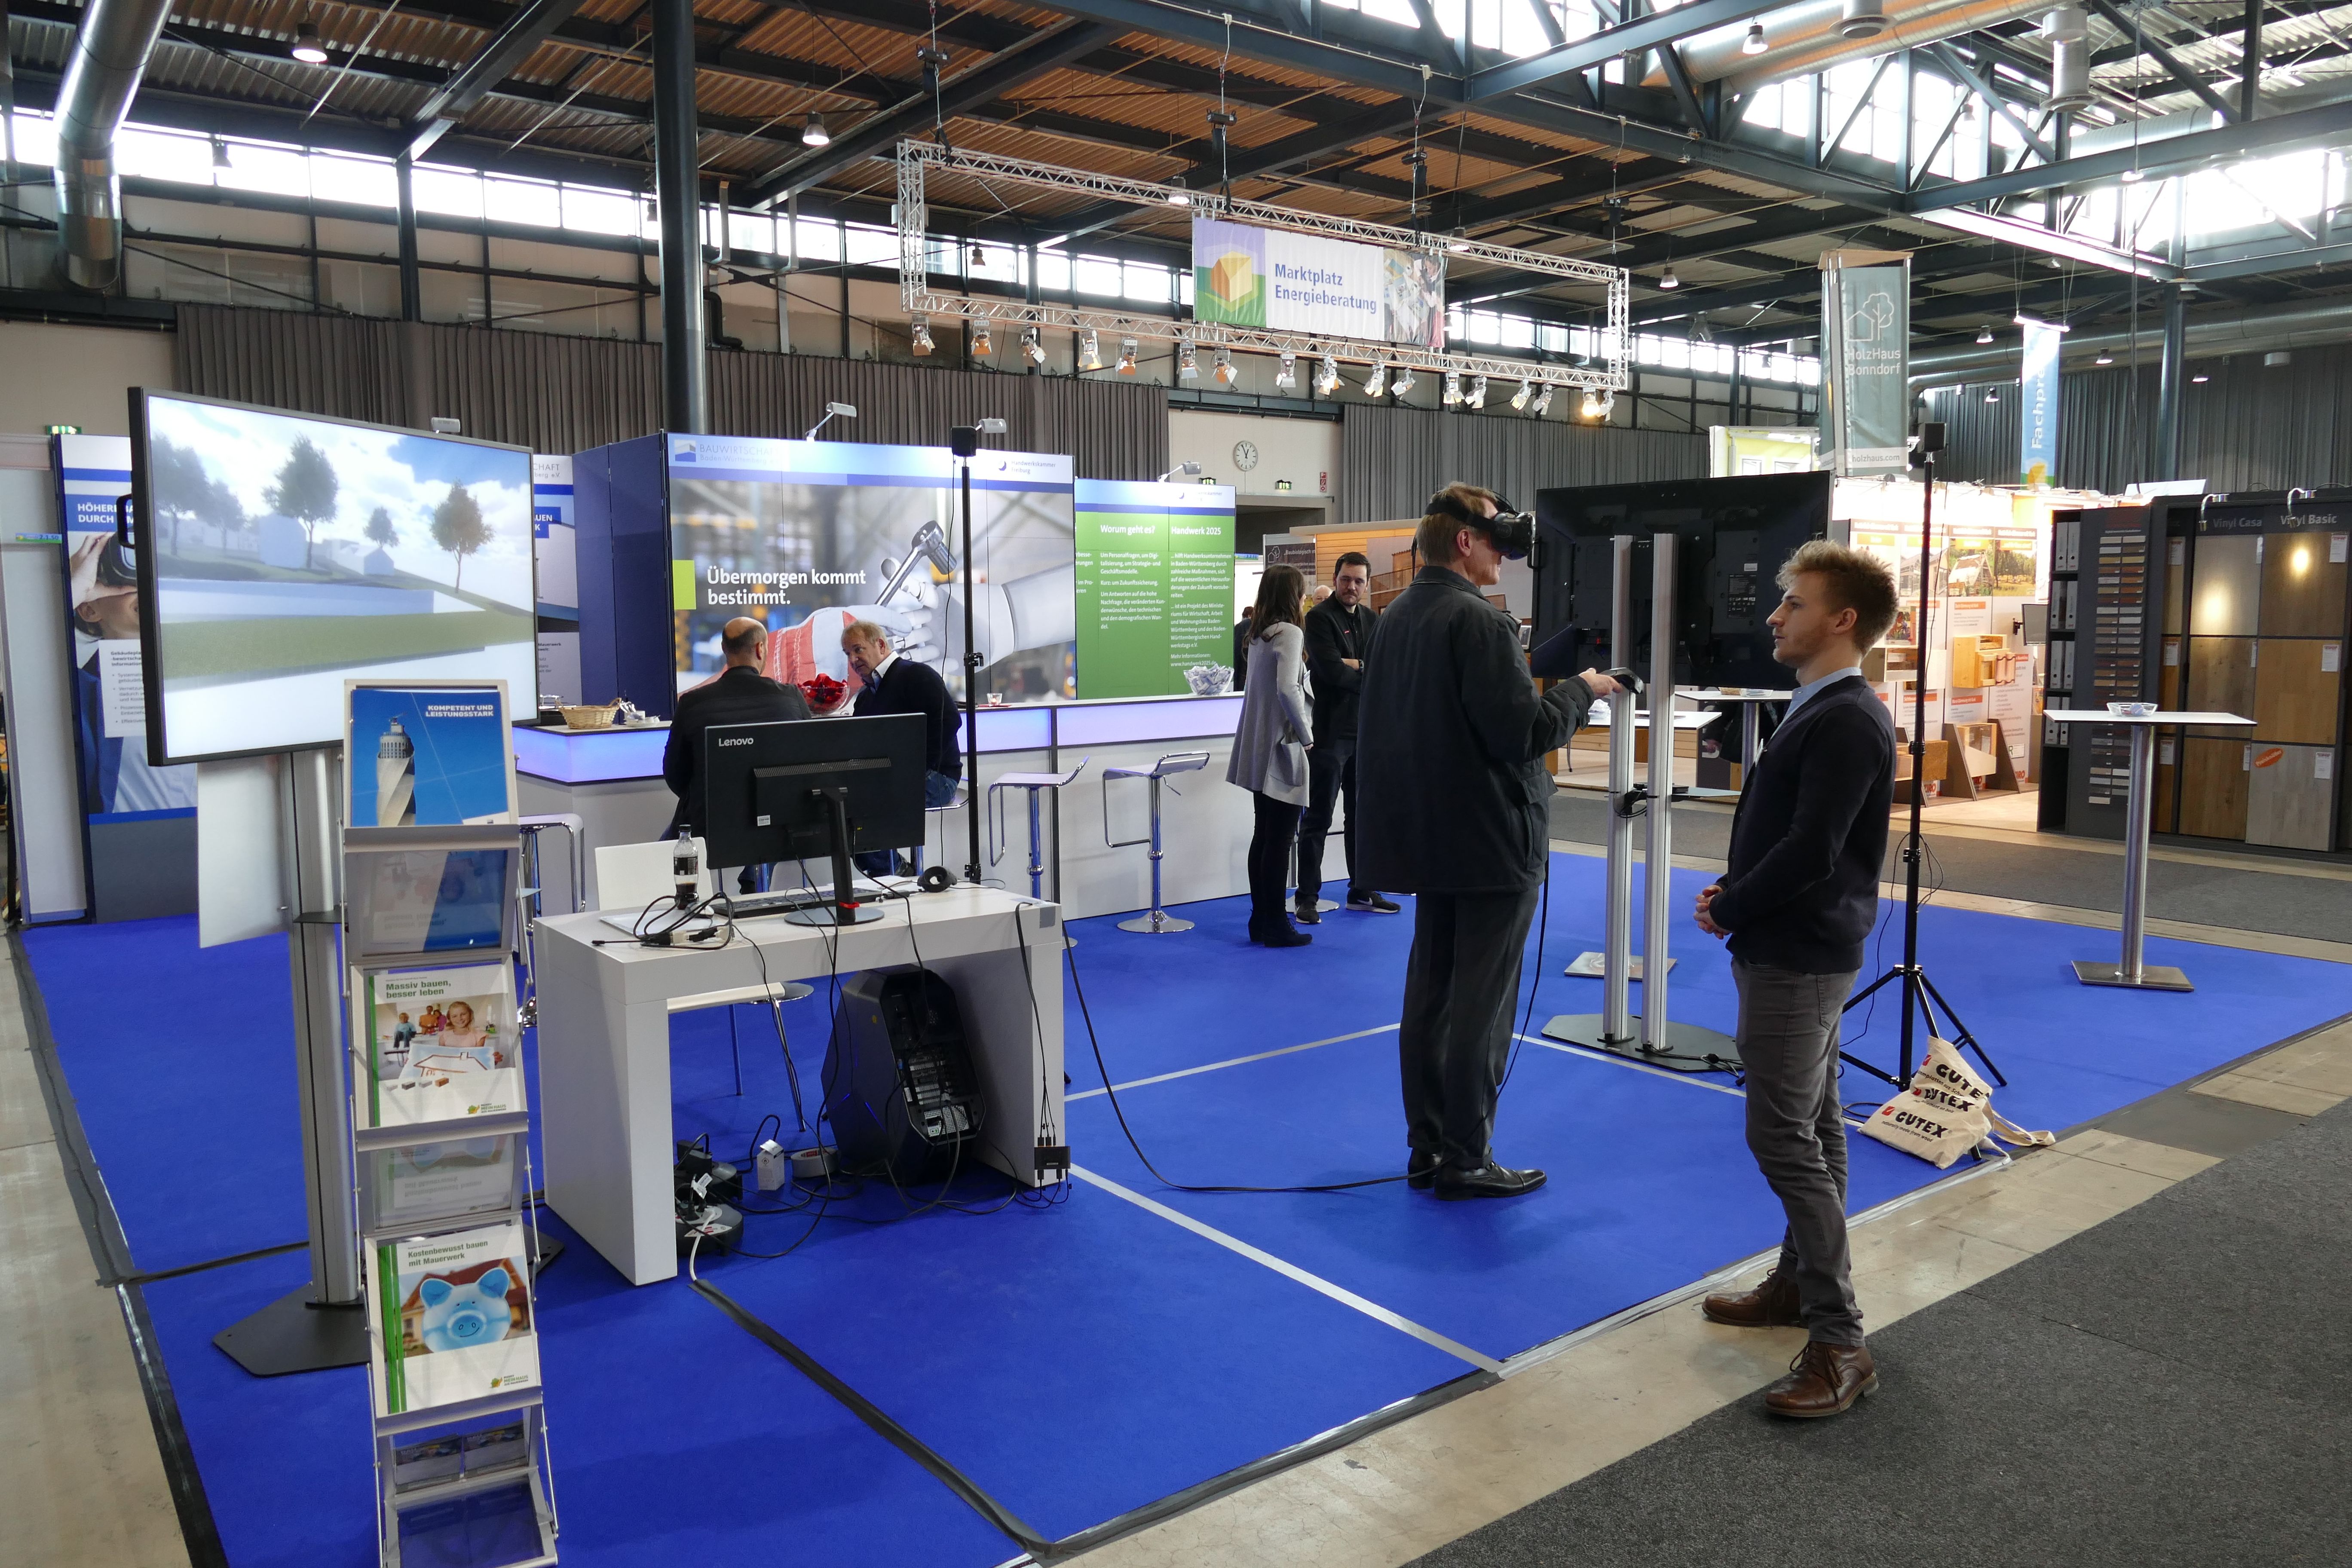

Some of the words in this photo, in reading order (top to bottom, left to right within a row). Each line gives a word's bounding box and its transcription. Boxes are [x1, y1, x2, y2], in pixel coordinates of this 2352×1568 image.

[1275, 263, 1343, 286] Marktplatz
[1275, 284, 1377, 314] Energieberatung
[1848, 347, 1901, 360] HolzHaus
[1848, 362, 1901, 376] Bonndorf
[1852, 454, 1900, 462] holzhaus.com
[78, 514, 114, 523] DURCH
[2213, 518, 2236, 530] Vinyl
[2239, 518, 2262, 528] Casa
[2280, 515, 2306, 527] Viyl
[2308, 514, 2337, 524] Basic
[1100, 524, 1126, 533] Worum
[1127, 525, 1143, 535] geht
[1144, 525, 1156, 534] es?
[1171, 526, 1205, 535] Handwerk
[707, 565, 807, 589] Übermorgen
[812, 568, 866, 584] kommt
[708, 589, 791, 605] bestimmt.
[719, 738, 754, 747] Lenovo
[386, 982, 418, 990] Massiv
[386, 990, 416, 998] besser
[1881, 1121, 1899, 1129] naturally
[1895, 1111, 1949, 1138] GUTEX
[408, 1243, 464, 1258] Kostenbewusst
[466, 1240, 488, 1249] bauen
[423, 1253, 465, 1265] Mauerwerk
